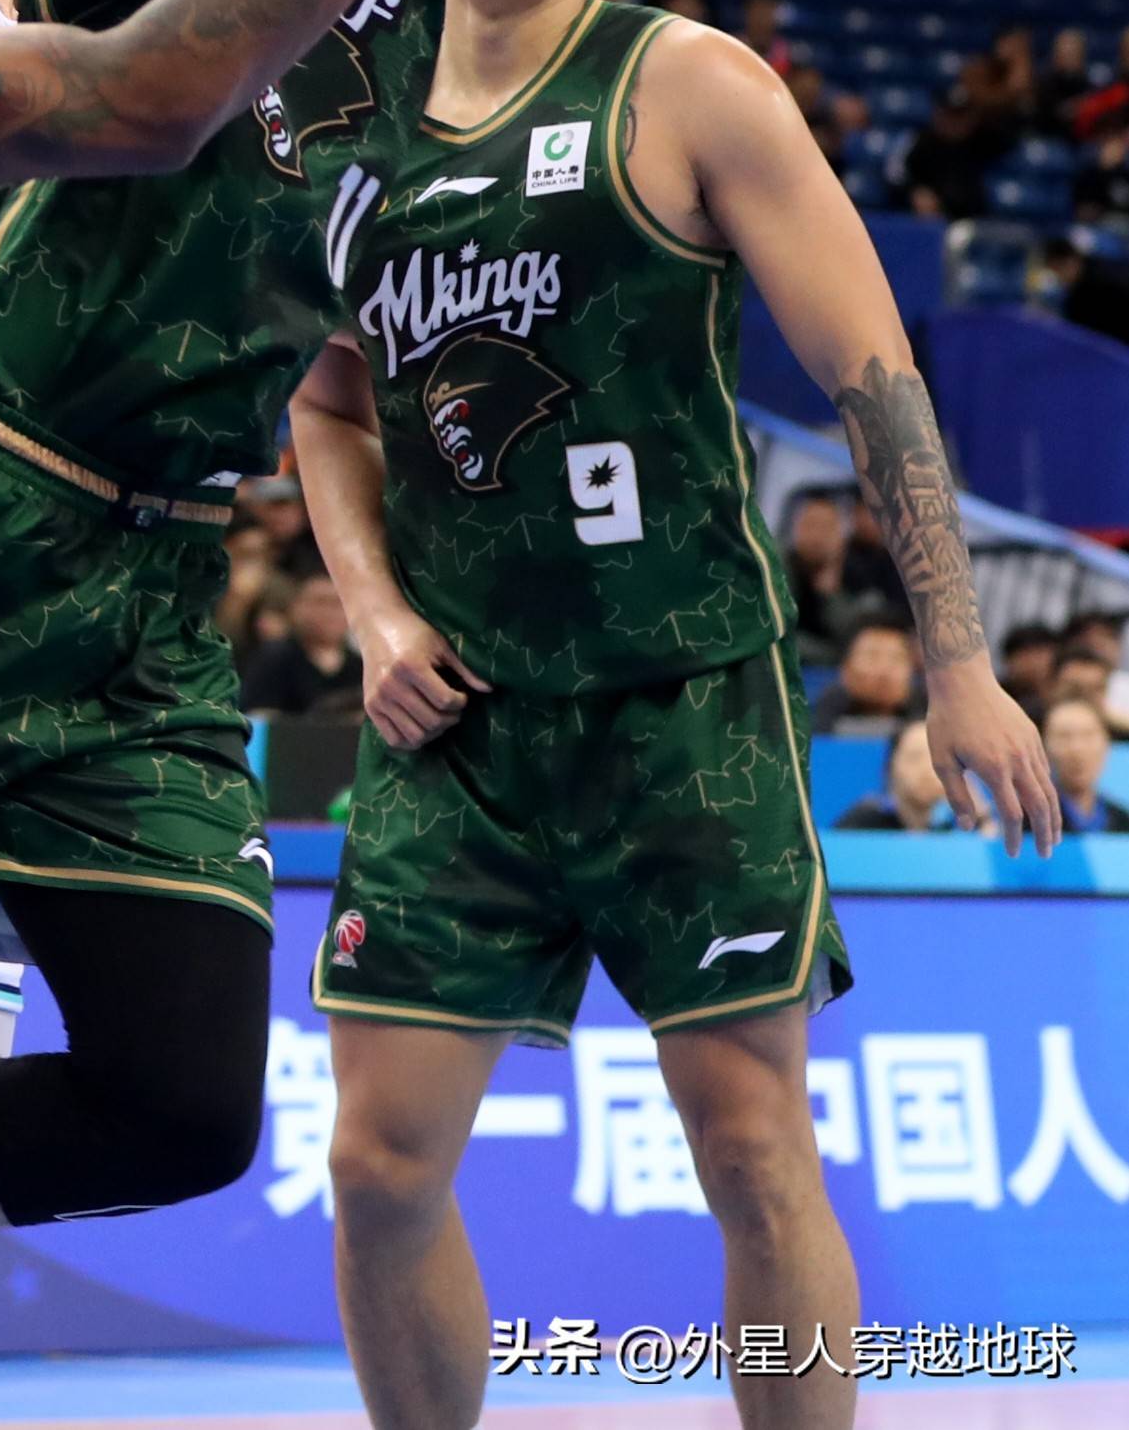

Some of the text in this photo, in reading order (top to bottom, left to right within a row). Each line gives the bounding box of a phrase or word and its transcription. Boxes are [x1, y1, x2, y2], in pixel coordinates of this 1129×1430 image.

[531, 179, 557, 189] CHINA
[358, 238, 561, 379] Mkings
[566, 441, 644, 546] 9
